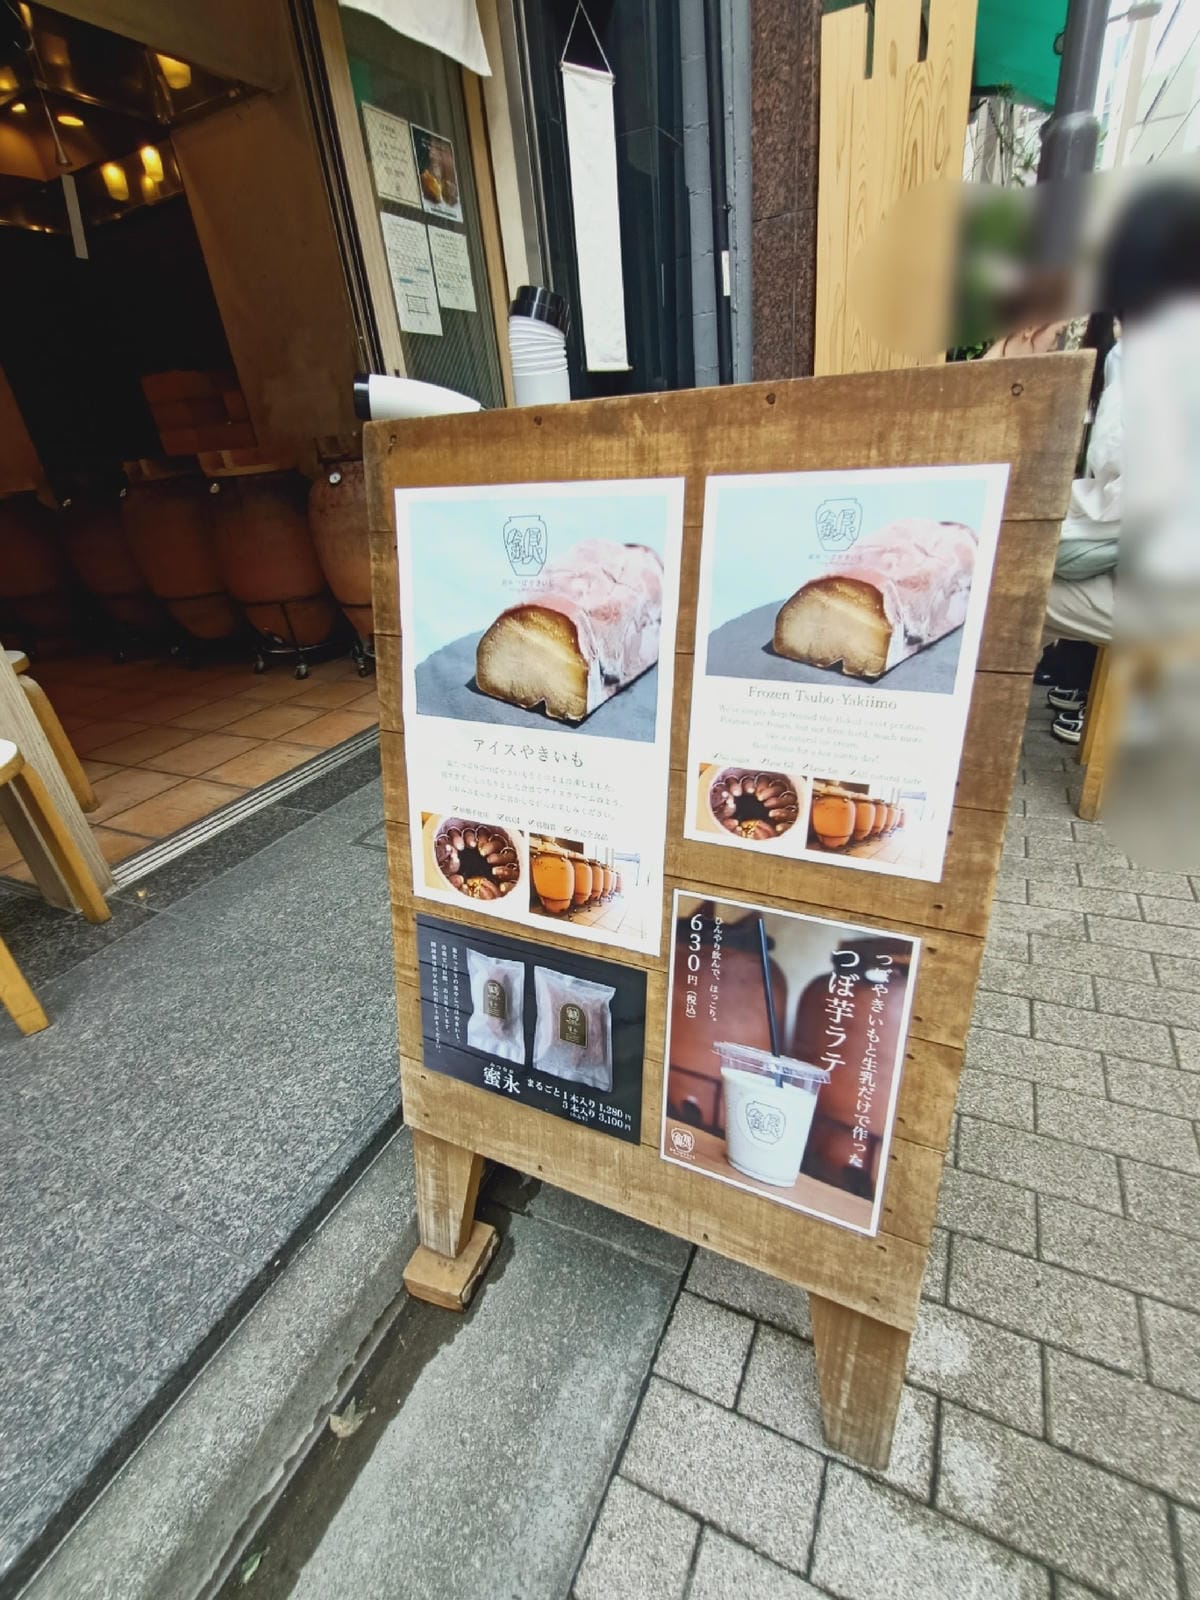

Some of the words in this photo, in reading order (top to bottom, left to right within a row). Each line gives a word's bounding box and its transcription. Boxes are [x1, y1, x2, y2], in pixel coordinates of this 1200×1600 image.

[748, 686, 790, 701] Frozen
[474, 738, 583, 768] アイスやきいも
[820, 950, 860, 1072] つぼ芋ラテ
[483, 1066, 521, 1094] 蜜永
